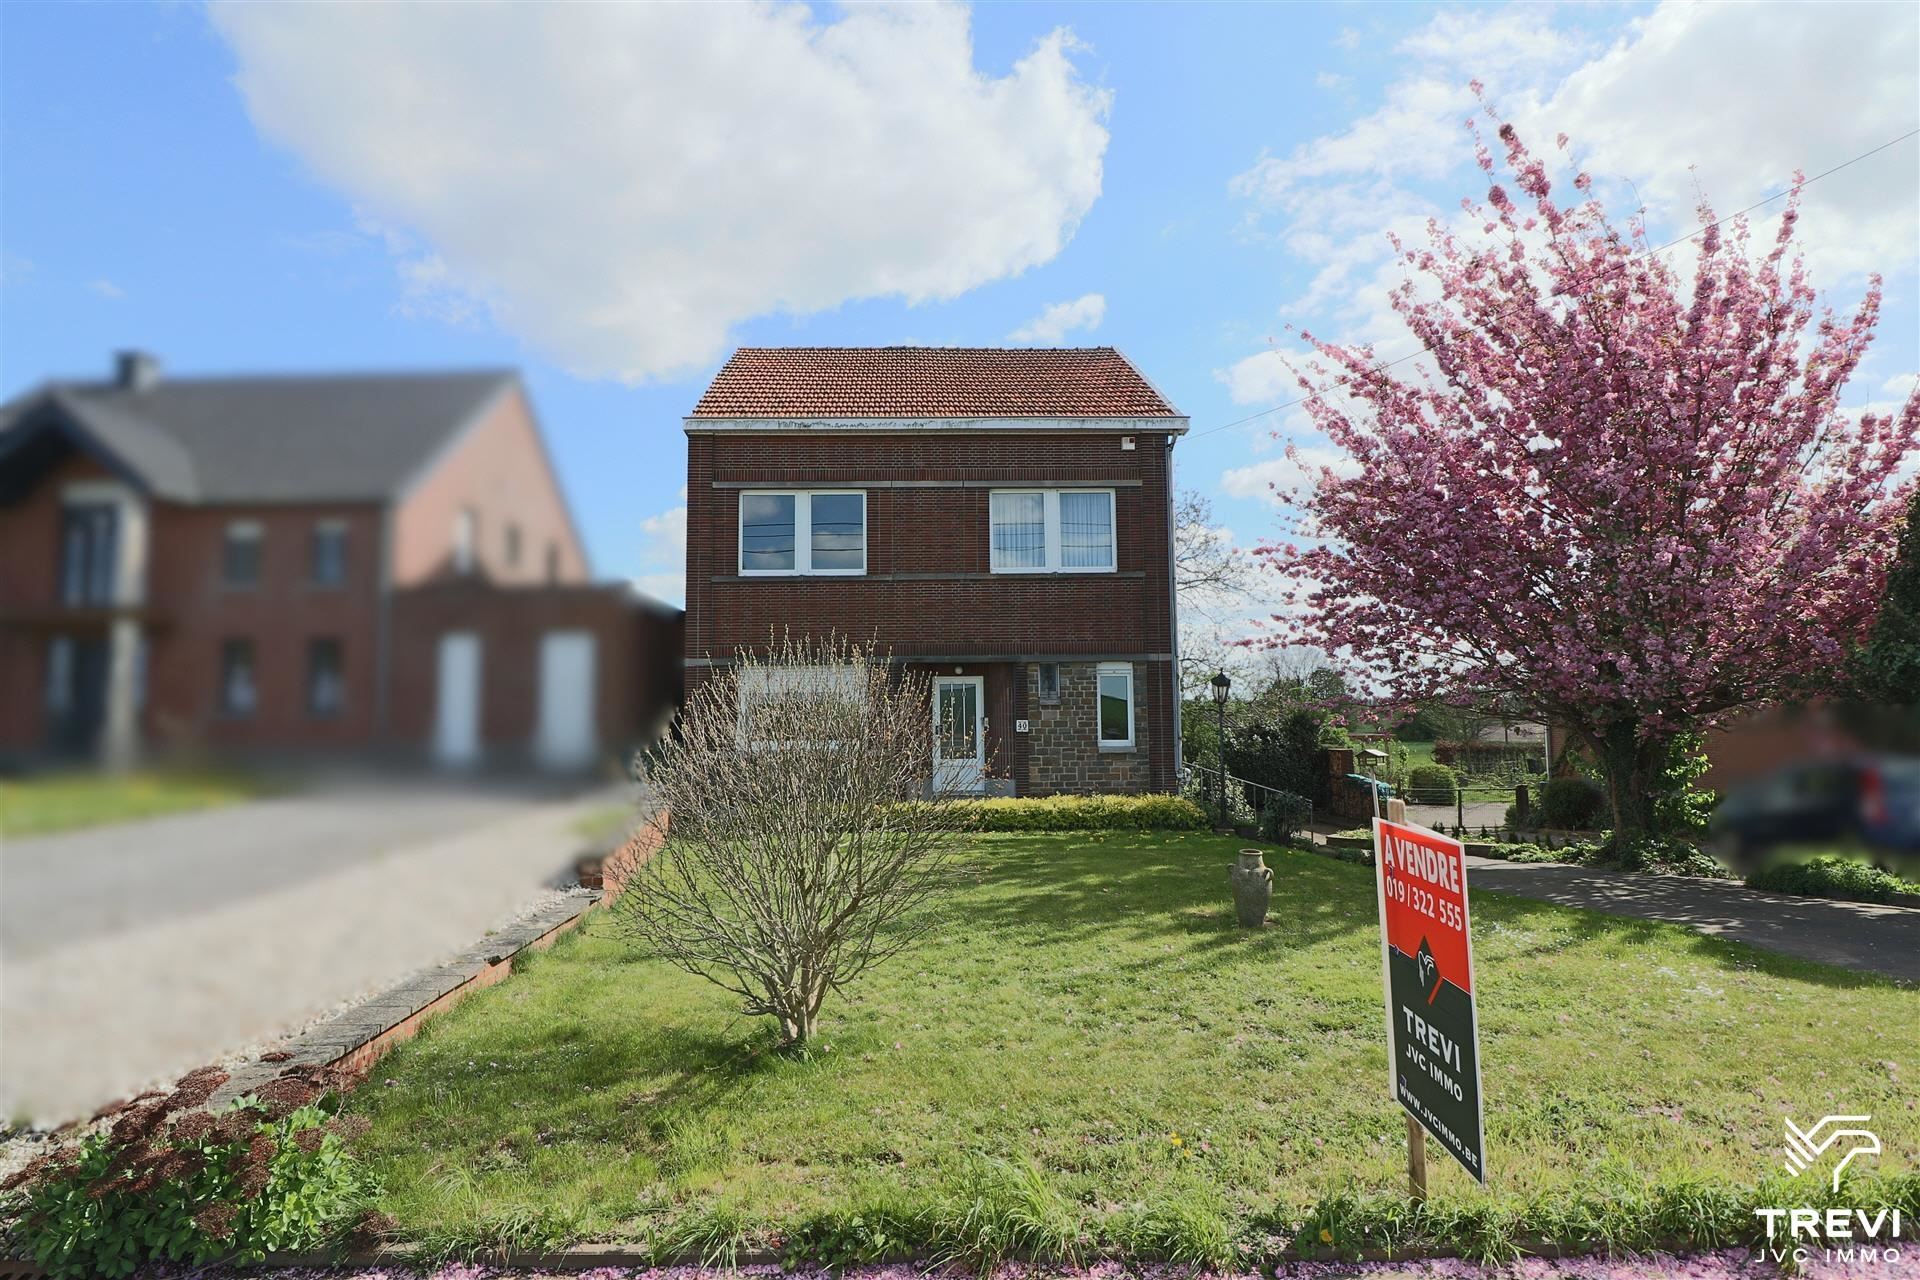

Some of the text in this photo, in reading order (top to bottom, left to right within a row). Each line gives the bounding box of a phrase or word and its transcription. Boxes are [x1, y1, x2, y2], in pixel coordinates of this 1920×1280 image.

[1385, 834, 1460, 894] A VENDRE
[1439, 898, 1462, 932] 555
[1402, 1004, 1462, 1074] TREVI
[1405, 1043, 1463, 1102] JVC IMMO
[1400, 1083, 1478, 1169] WWW.JVCIMMO.BE
